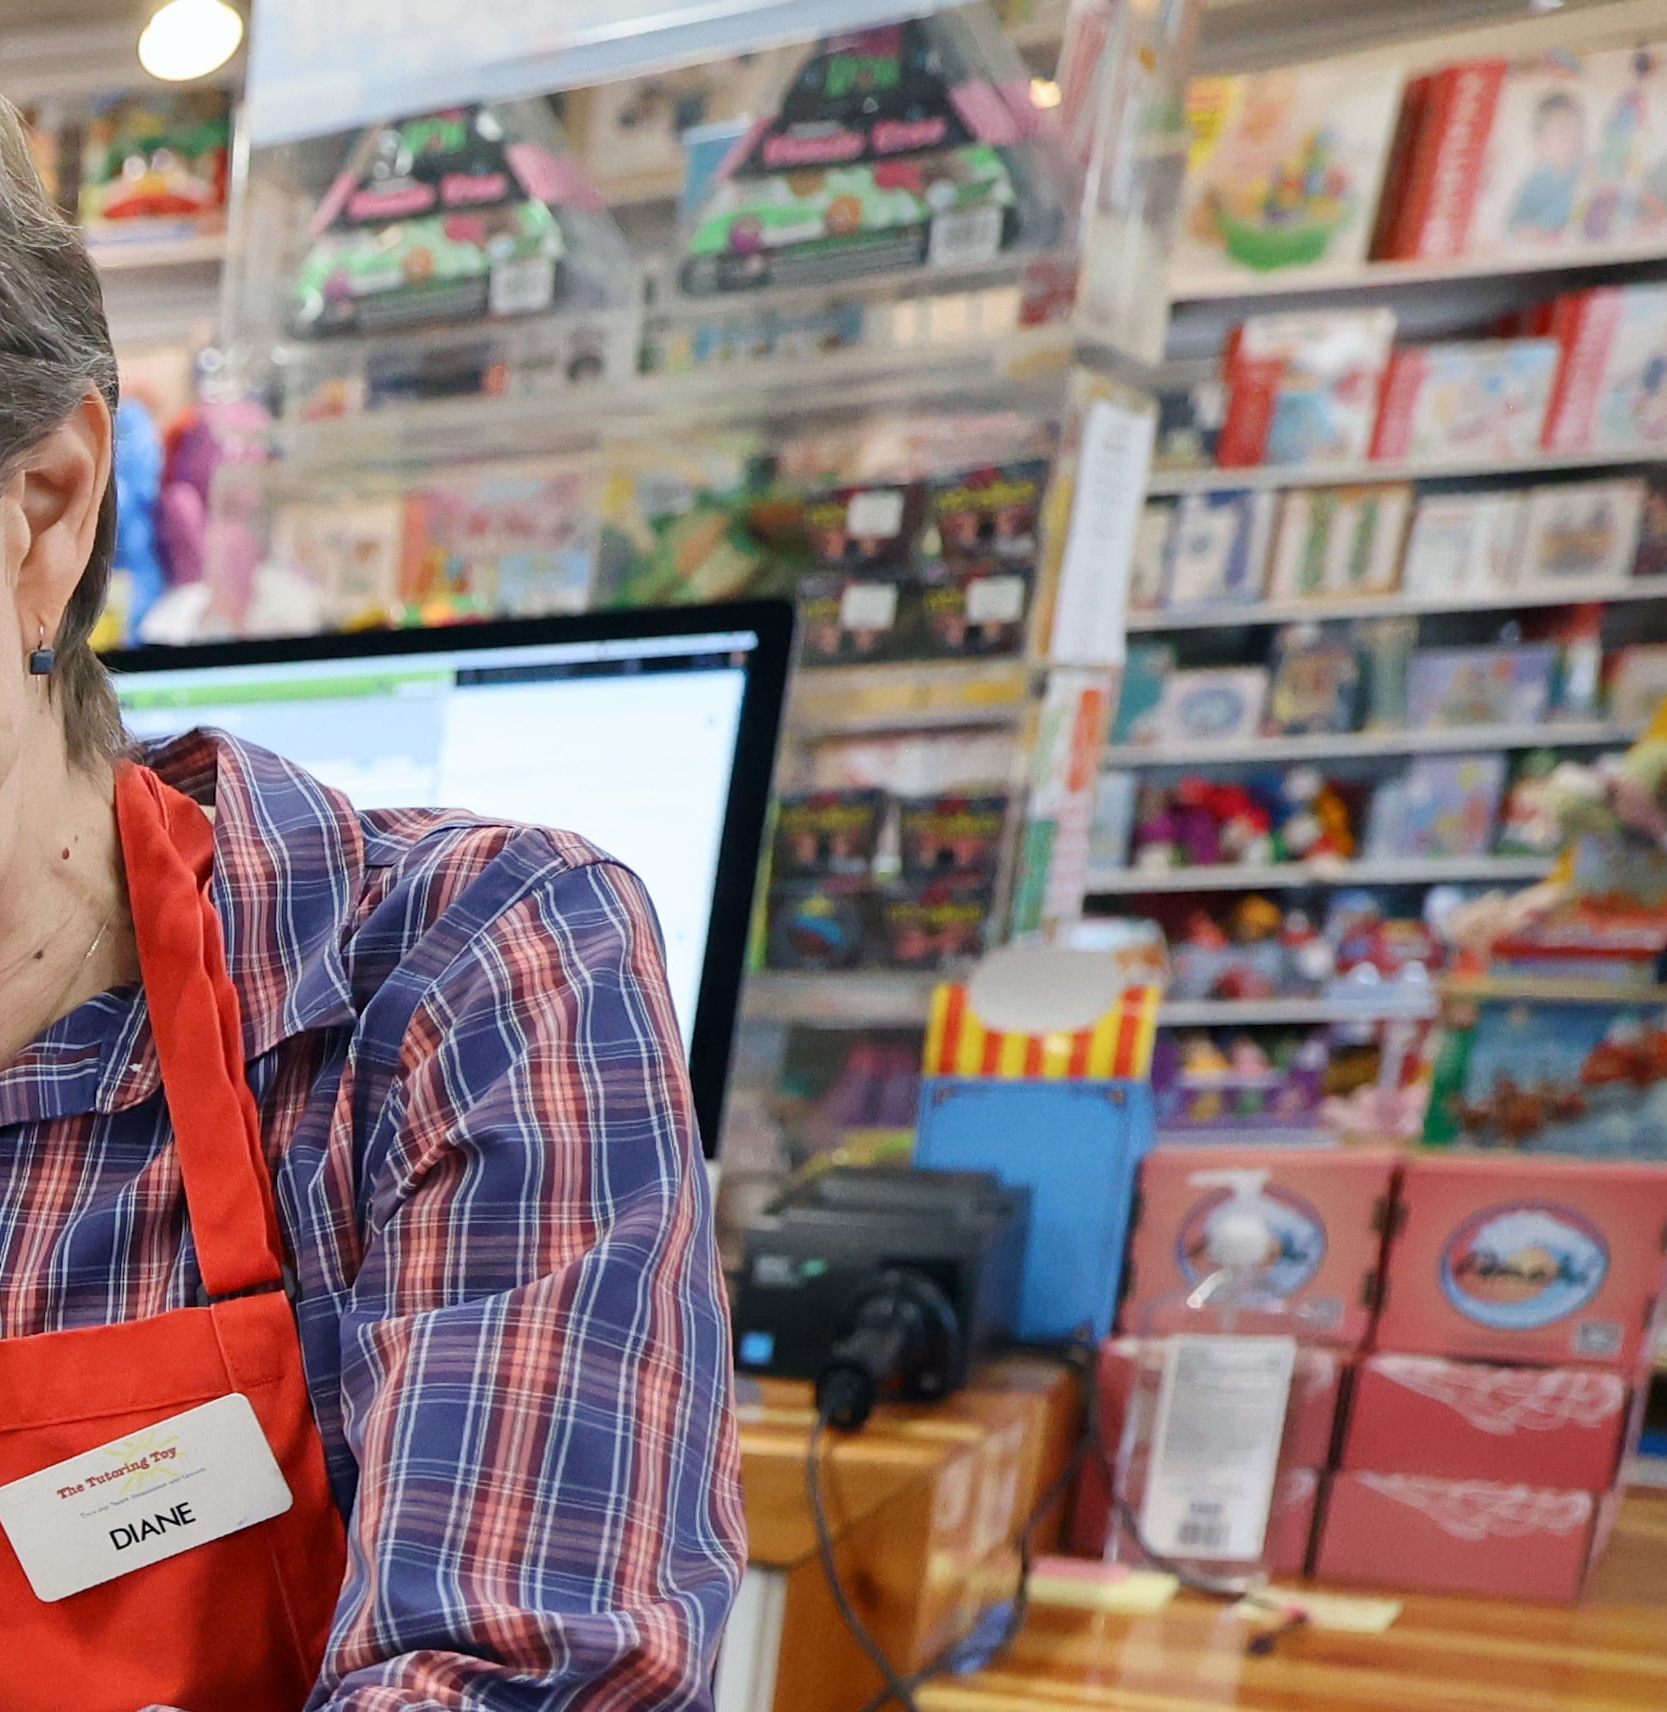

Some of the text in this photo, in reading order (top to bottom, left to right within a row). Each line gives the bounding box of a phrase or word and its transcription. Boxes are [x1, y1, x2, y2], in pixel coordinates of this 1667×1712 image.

[56, 1446, 178, 1500] The Tutoring Toy
[108, 1501, 197, 1551] DIANE
